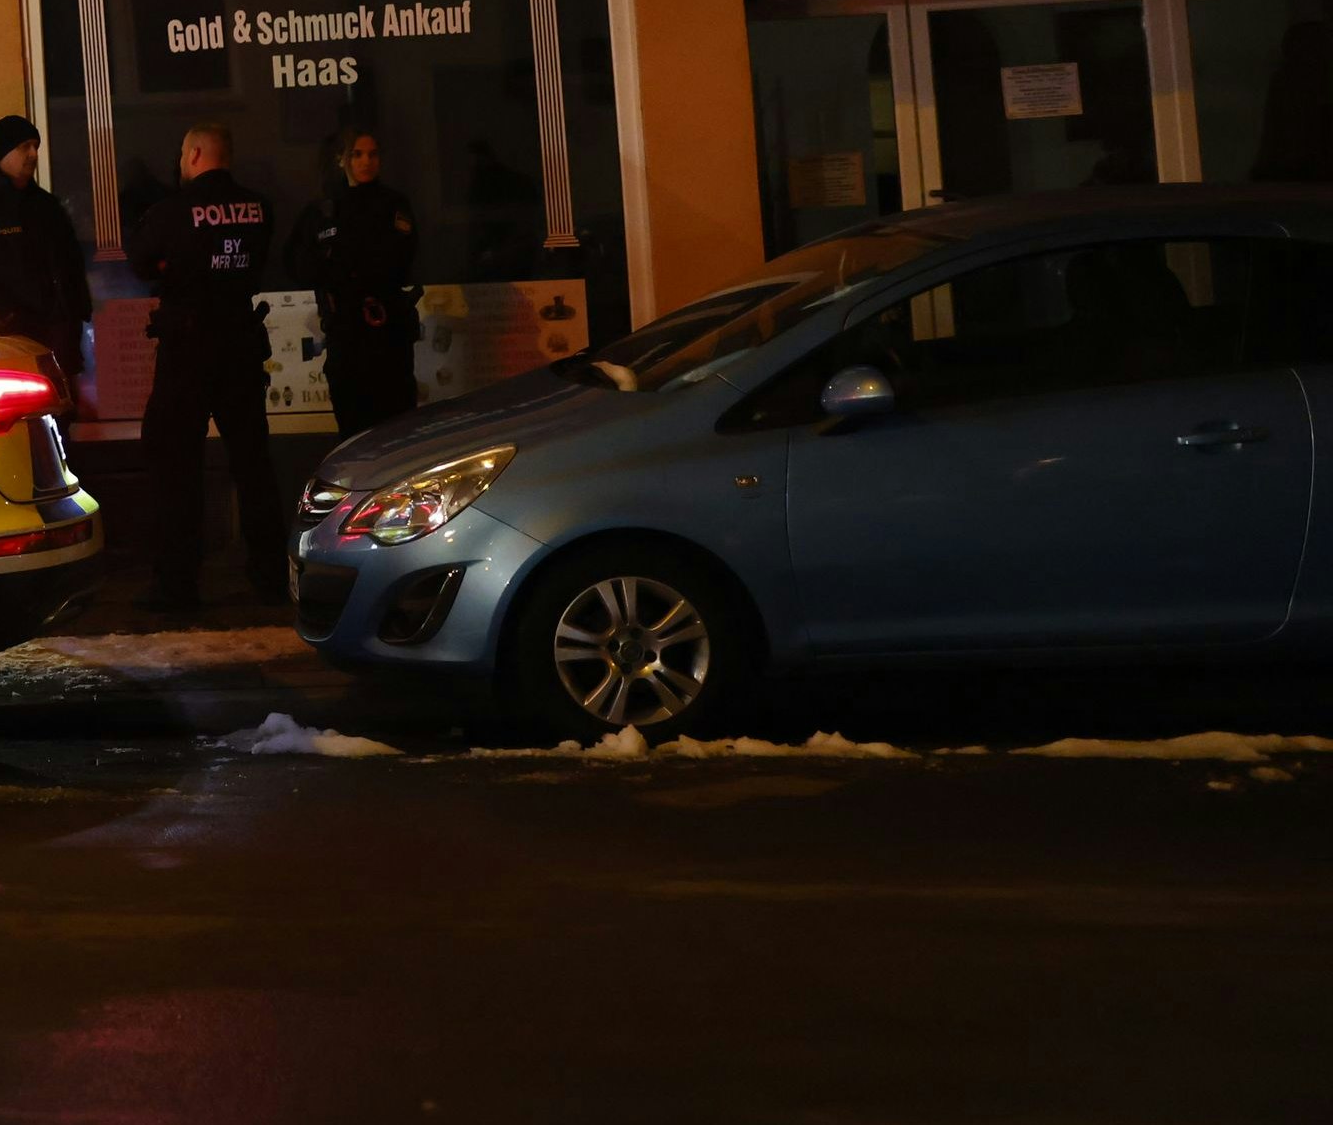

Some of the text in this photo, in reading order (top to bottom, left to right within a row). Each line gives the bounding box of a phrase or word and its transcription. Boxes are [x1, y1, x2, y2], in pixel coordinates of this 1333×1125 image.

[167, 0, 472, 53] Gold & Schmuck Ankauf
[272, 54, 359, 89] Haas
[191, 202, 264, 228] POLIZEI
[224, 238, 242, 254] BY
[211, 254, 231, 270] MFR
